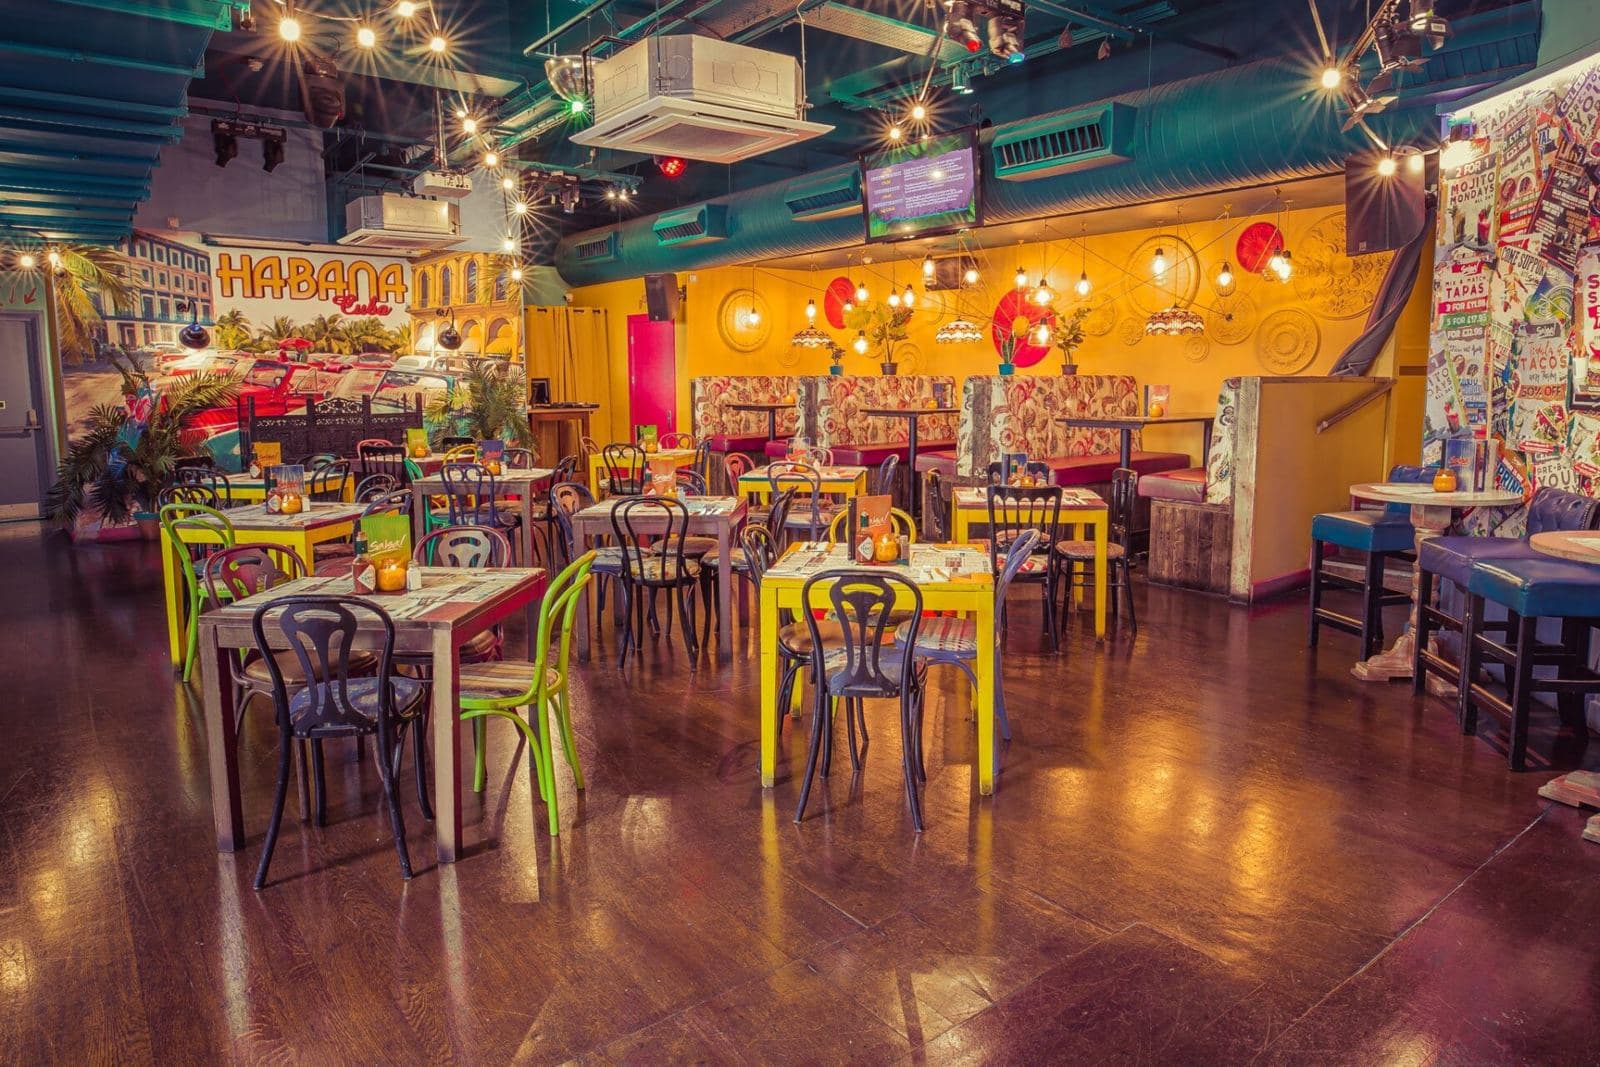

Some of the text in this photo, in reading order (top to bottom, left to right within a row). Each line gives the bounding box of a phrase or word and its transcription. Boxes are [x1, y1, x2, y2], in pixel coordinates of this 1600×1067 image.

[1456, 167, 1462, 178] 2
[1464, 160, 1482, 176] FOR
[1484, 158, 1489, 169] 1
[1451, 171, 1495, 196] MOJITO
[1450, 183, 1495, 206] MONDAYS
[216, 252, 408, 304] HABANA
[1466, 274, 1487, 283] MATCH
[1446, 282, 1485, 299] TAPAS
[332, 294, 392, 316] Cuba
[1453, 316, 1466, 326] FOR
[1448, 329, 1461, 340] FOR
[1520, 354, 1568, 371] TACOS
[1521, 385, 1562, 398] 50% OFF
[369, 534, 407, 552] Salsa!
